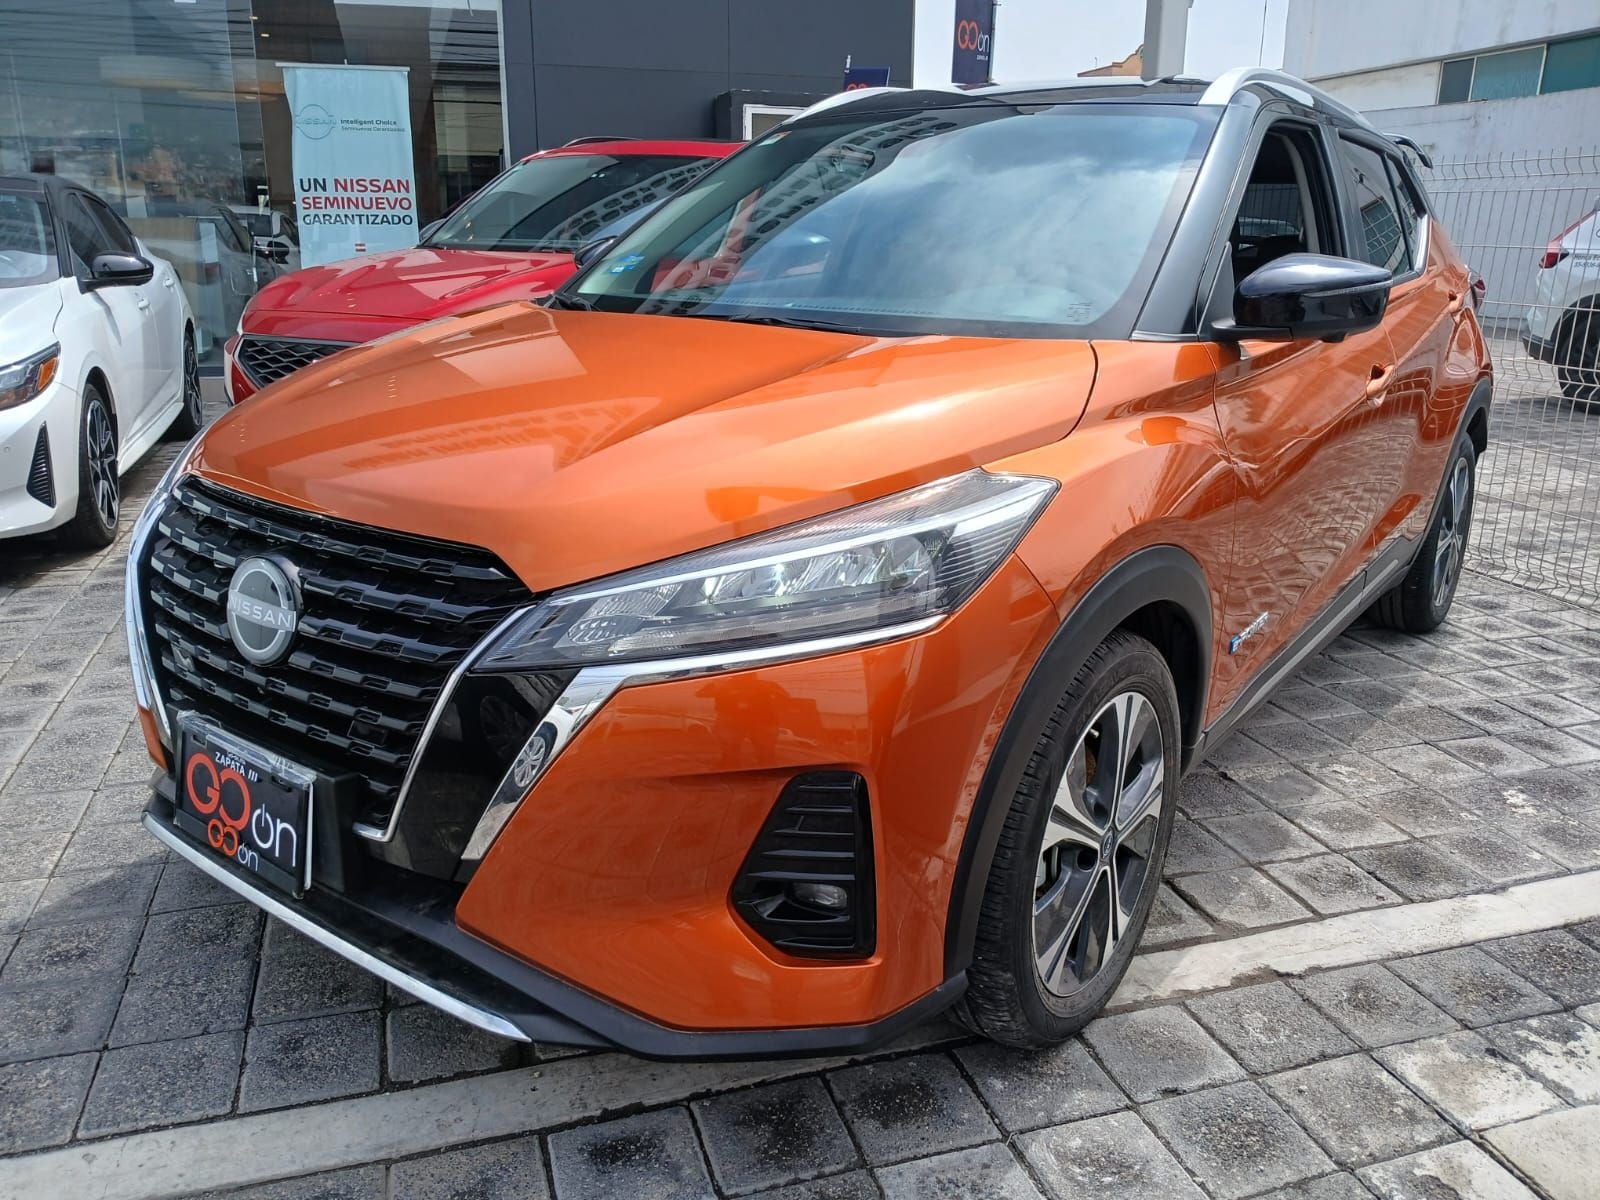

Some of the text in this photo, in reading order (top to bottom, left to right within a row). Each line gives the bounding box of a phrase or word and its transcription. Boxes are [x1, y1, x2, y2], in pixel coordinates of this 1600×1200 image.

[299, 178, 410, 194] UN NISSAN
[302, 197, 412, 210] SEMINUEVO
[303, 213, 413, 226] GARANTIZADO
[229, 594, 293, 629] NISSAN
[215, 751, 246, 777] ZAPATA
[247, 768, 258, 783] III
